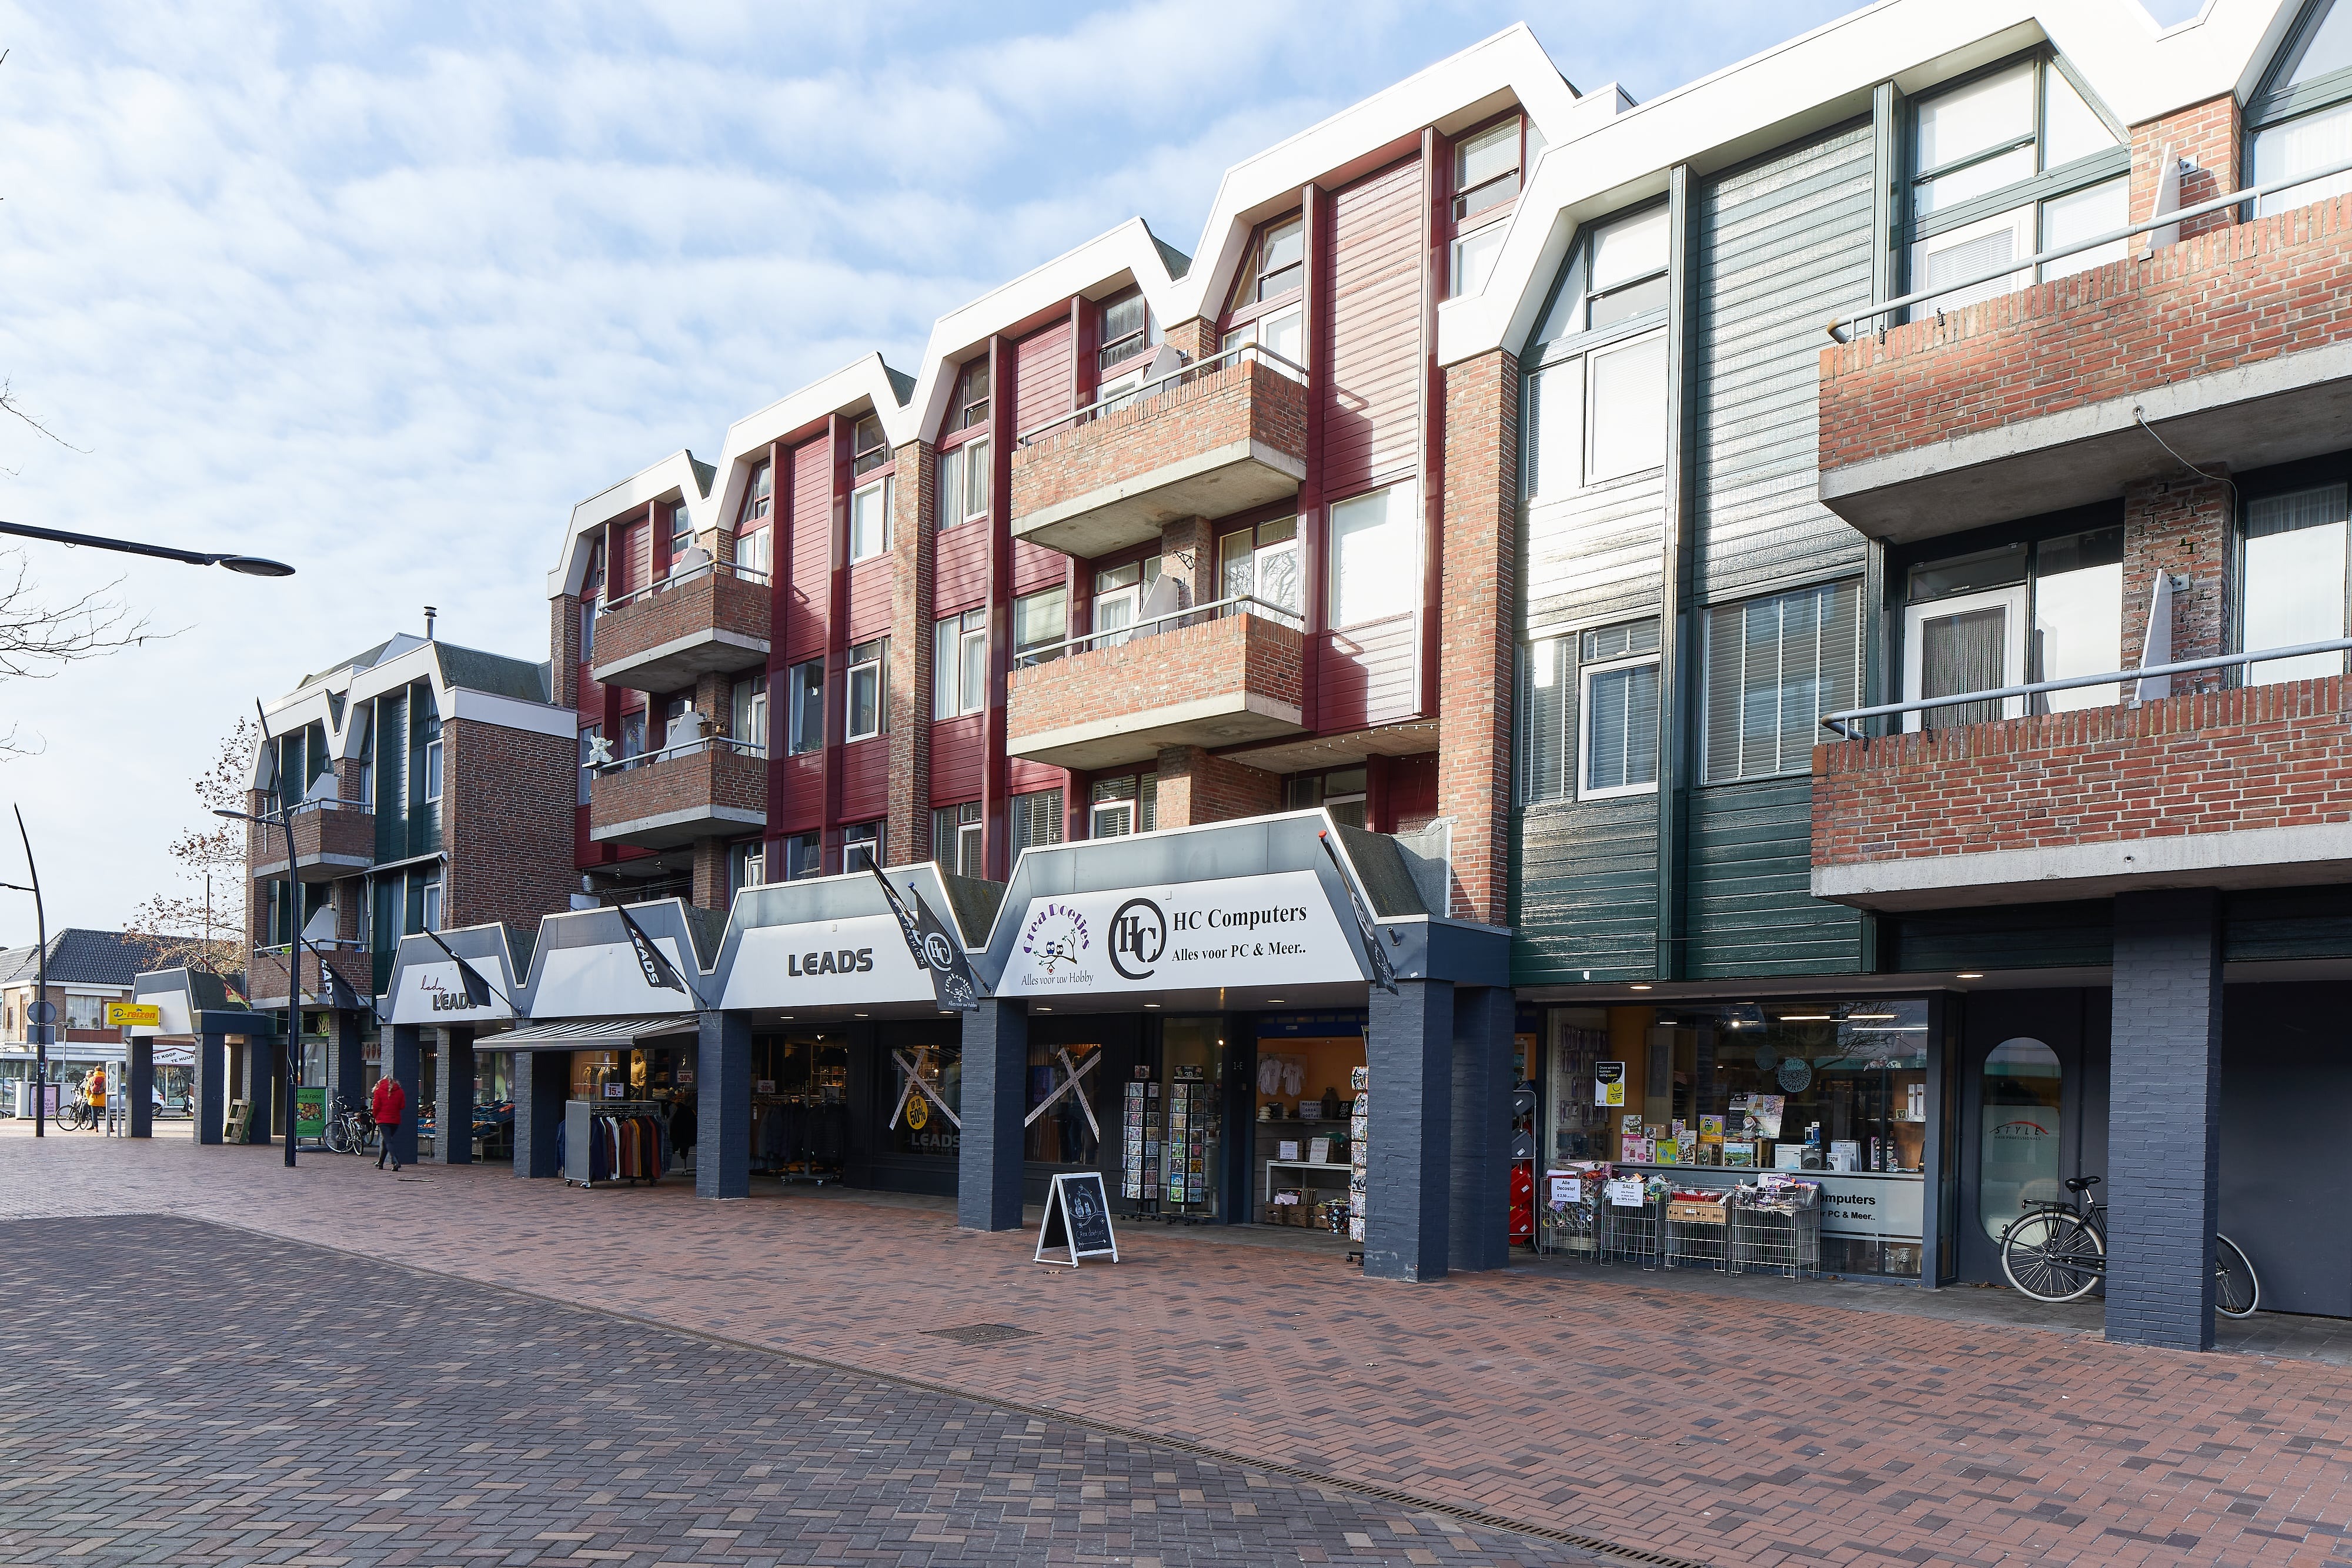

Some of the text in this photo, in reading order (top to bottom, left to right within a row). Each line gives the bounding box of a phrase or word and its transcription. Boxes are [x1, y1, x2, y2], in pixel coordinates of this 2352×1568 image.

[1173, 905, 1307, 931] HC Computers
[1023, 903, 1090, 954] Crea Doetjes
[903, 922, 926, 965] FASHION
[1172, 941, 1306, 961] Alles voor PC & Meer..
[630, 928, 660, 984] LEADS
[789, 948, 873, 977] LEADS
[1021, 974, 1038, 985] Alles
[1040, 976, 1056, 984] voor
[1070, 970, 1094, 985] Hobby
[420, 974, 447, 1004] lady
[433, 992, 477, 1011] LEAD
[113, 1008, 156, 1019] D-reizen
[1075, 1066, 1087, 1078] SALE
[1060, 1081, 1071, 1093] SALE
[911, 1098, 921, 1109] UP TO
[1044, 1096, 1054, 1108] SALE
[1081, 1098, 1091, 1114] SALE
[910, 1106, 926, 1125] 50%
[1028, 1110, 1039, 1122] SALE
[1994, 1126, 2040, 1135] STYLE
[911, 1133, 960, 1148] LEADS
